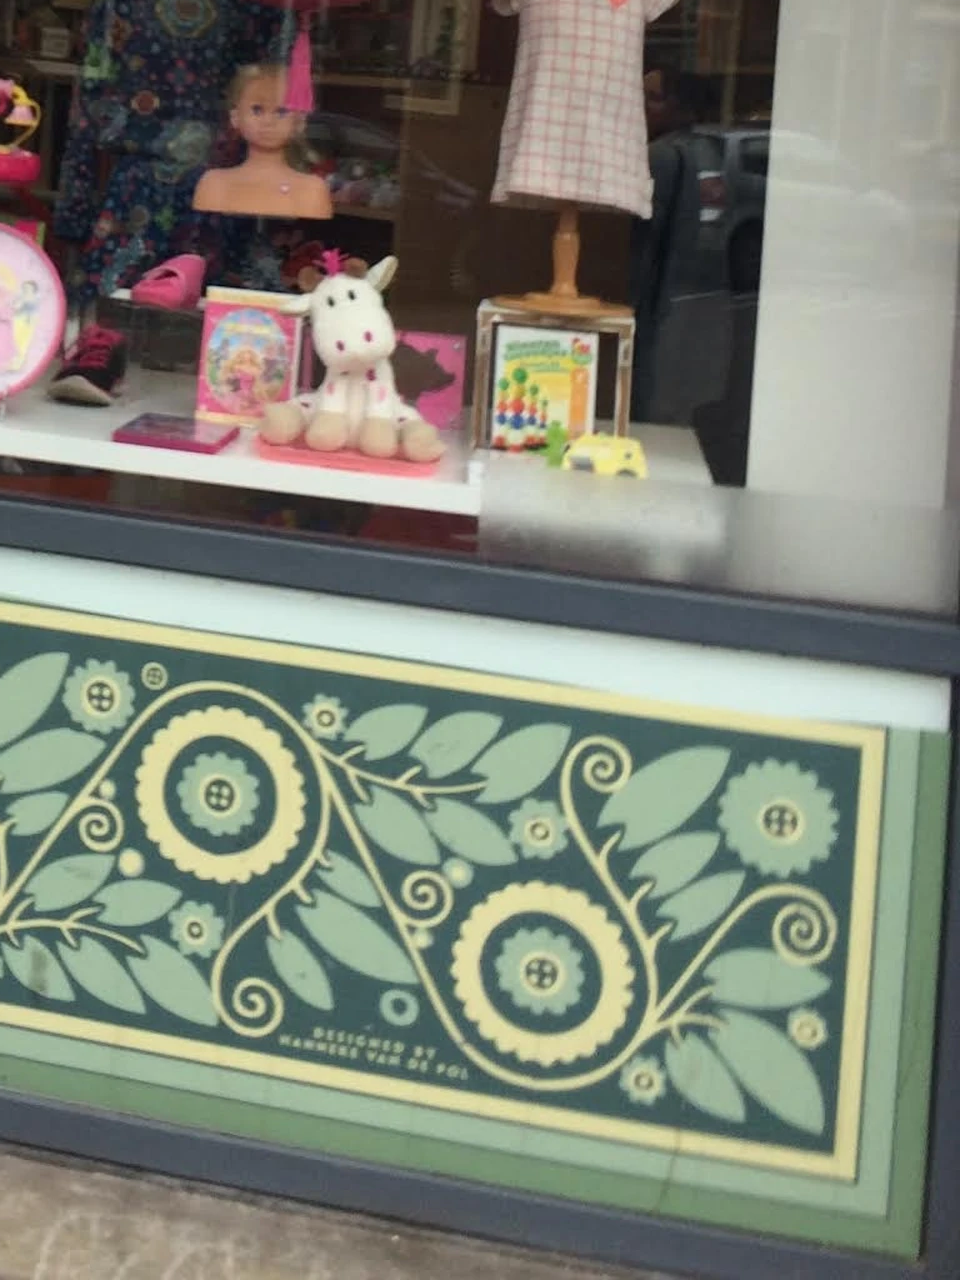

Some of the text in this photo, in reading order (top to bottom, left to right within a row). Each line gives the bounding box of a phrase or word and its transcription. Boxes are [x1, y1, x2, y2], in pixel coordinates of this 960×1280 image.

[312, 1026, 437, 1061] DESIGNED BY
[365, 1050, 402, 1067] VAN
[406, 1056, 429, 1074] DE
